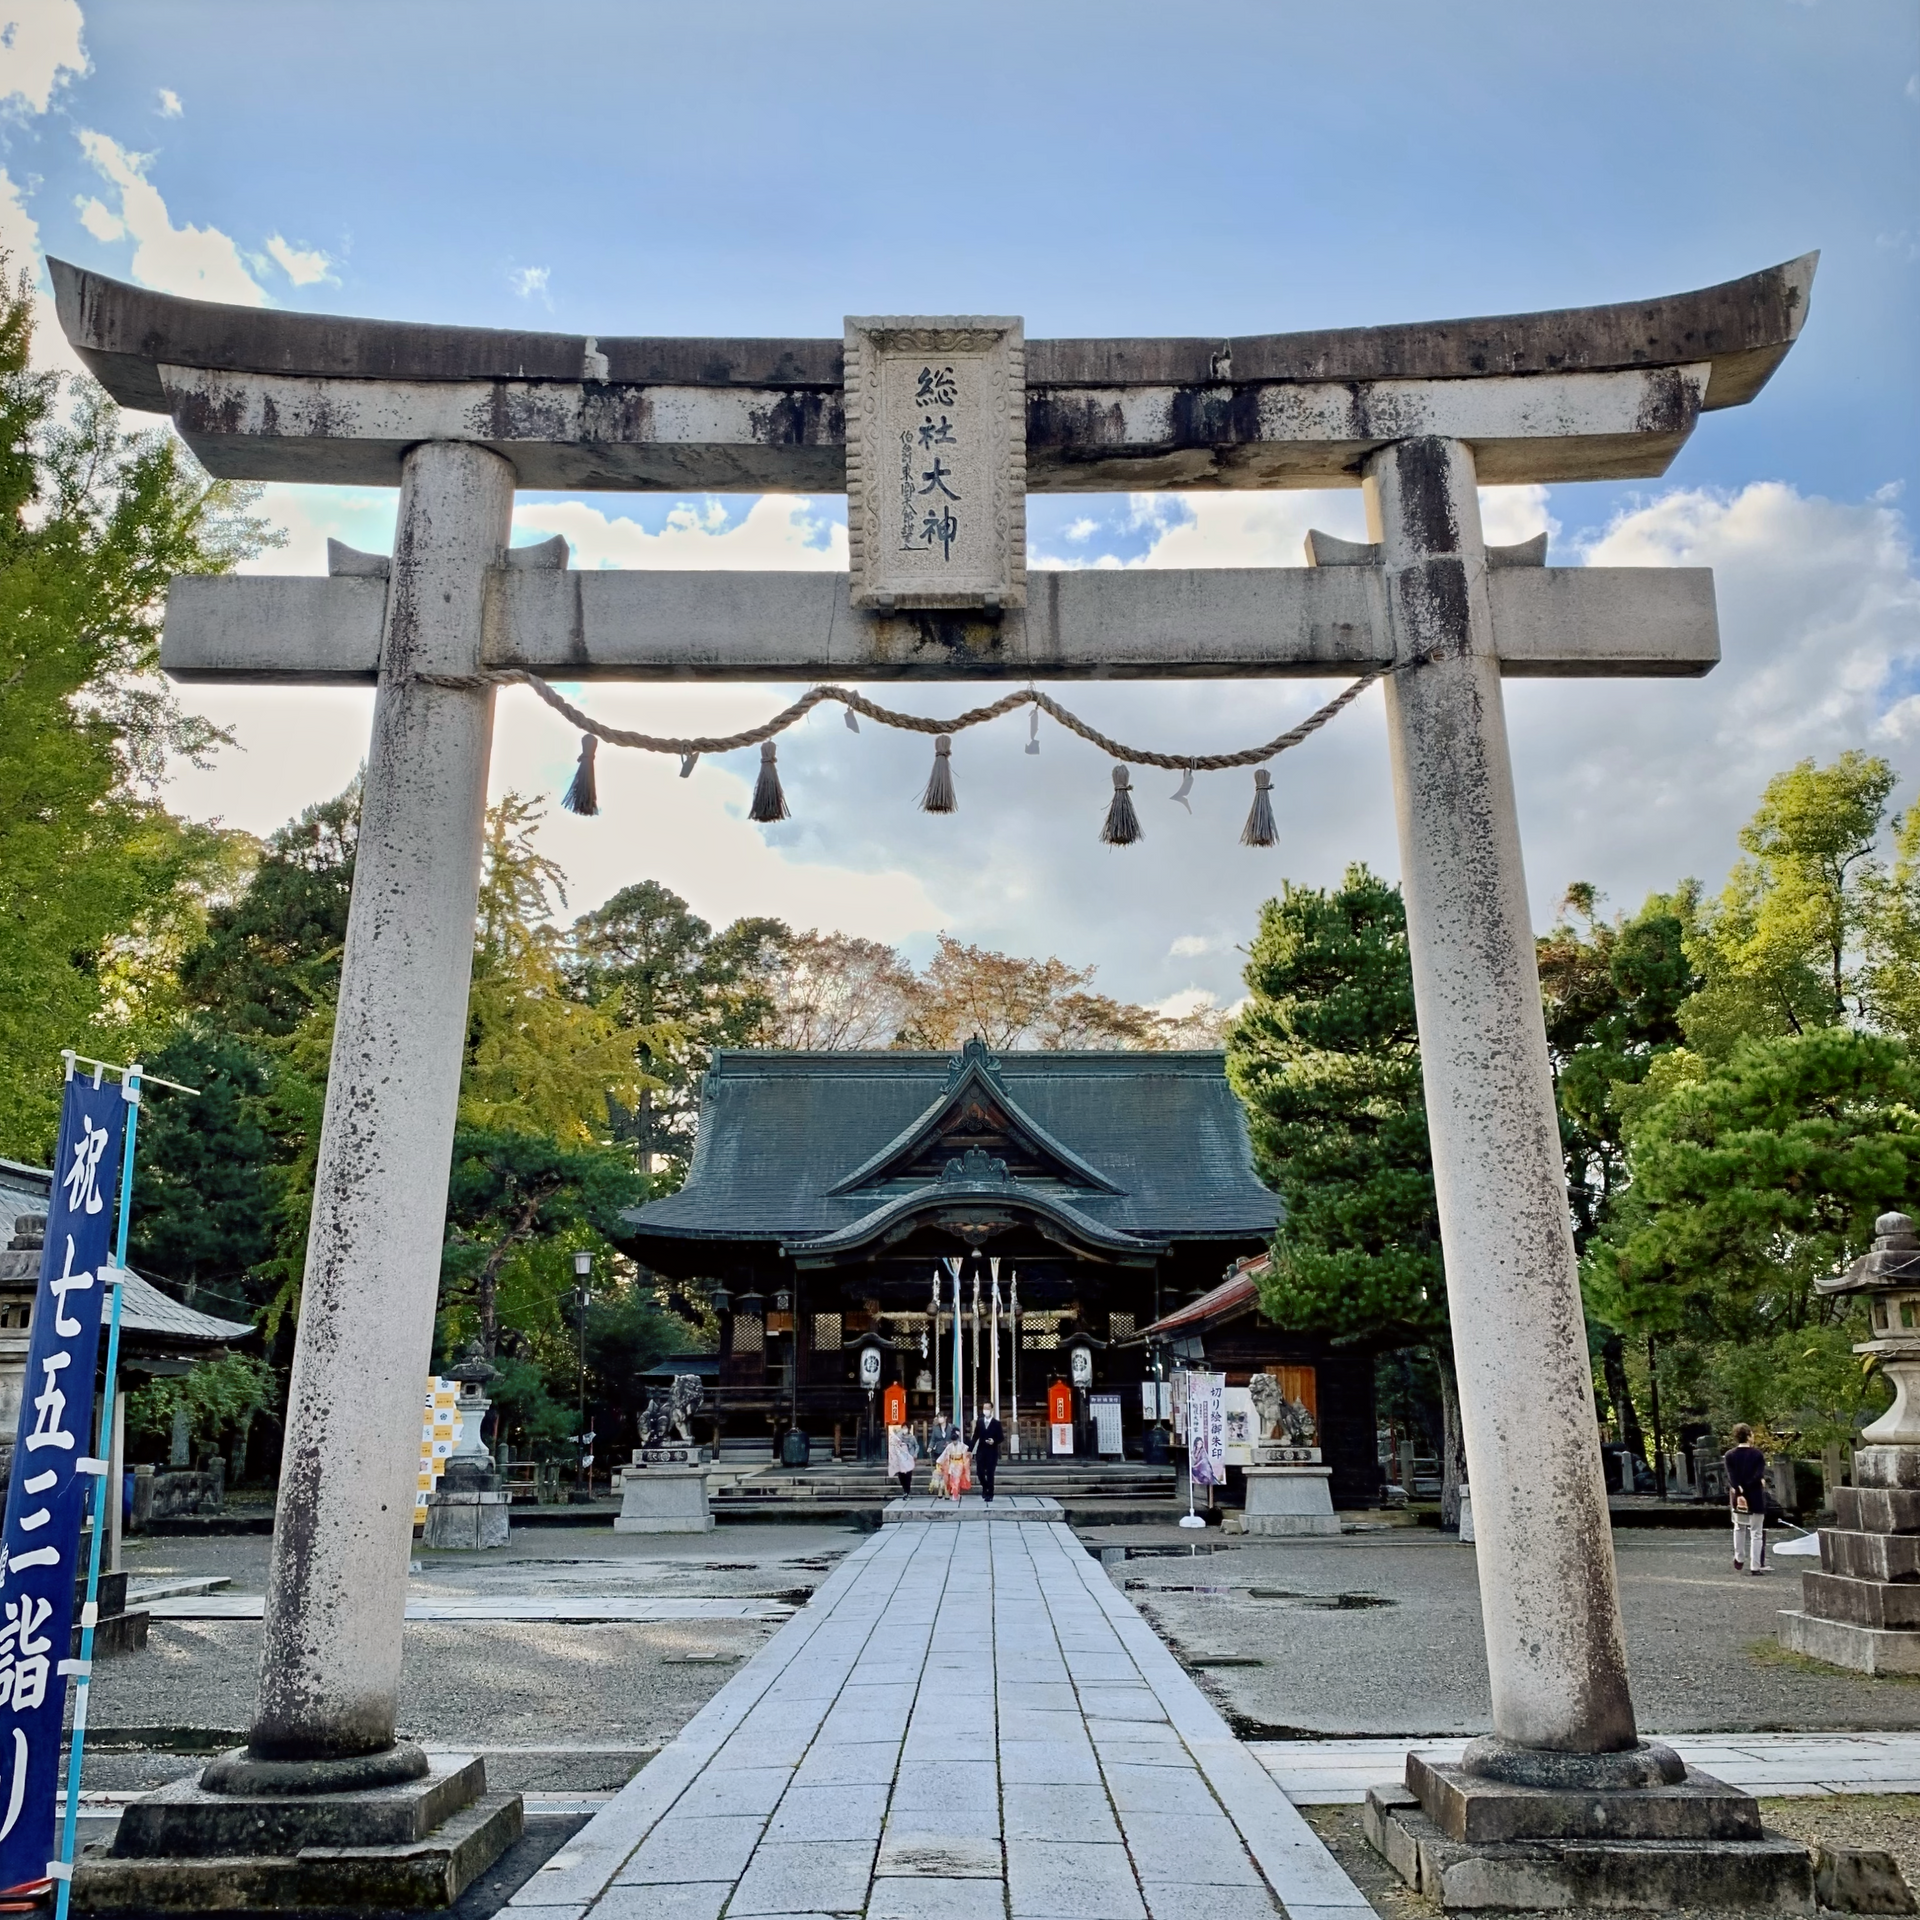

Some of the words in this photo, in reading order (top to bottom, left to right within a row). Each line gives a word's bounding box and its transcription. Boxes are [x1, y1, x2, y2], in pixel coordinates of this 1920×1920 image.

[914, 366, 962, 562] 総社大神
[1210, 1387, 1223, 1460] 切り絵御朱印
